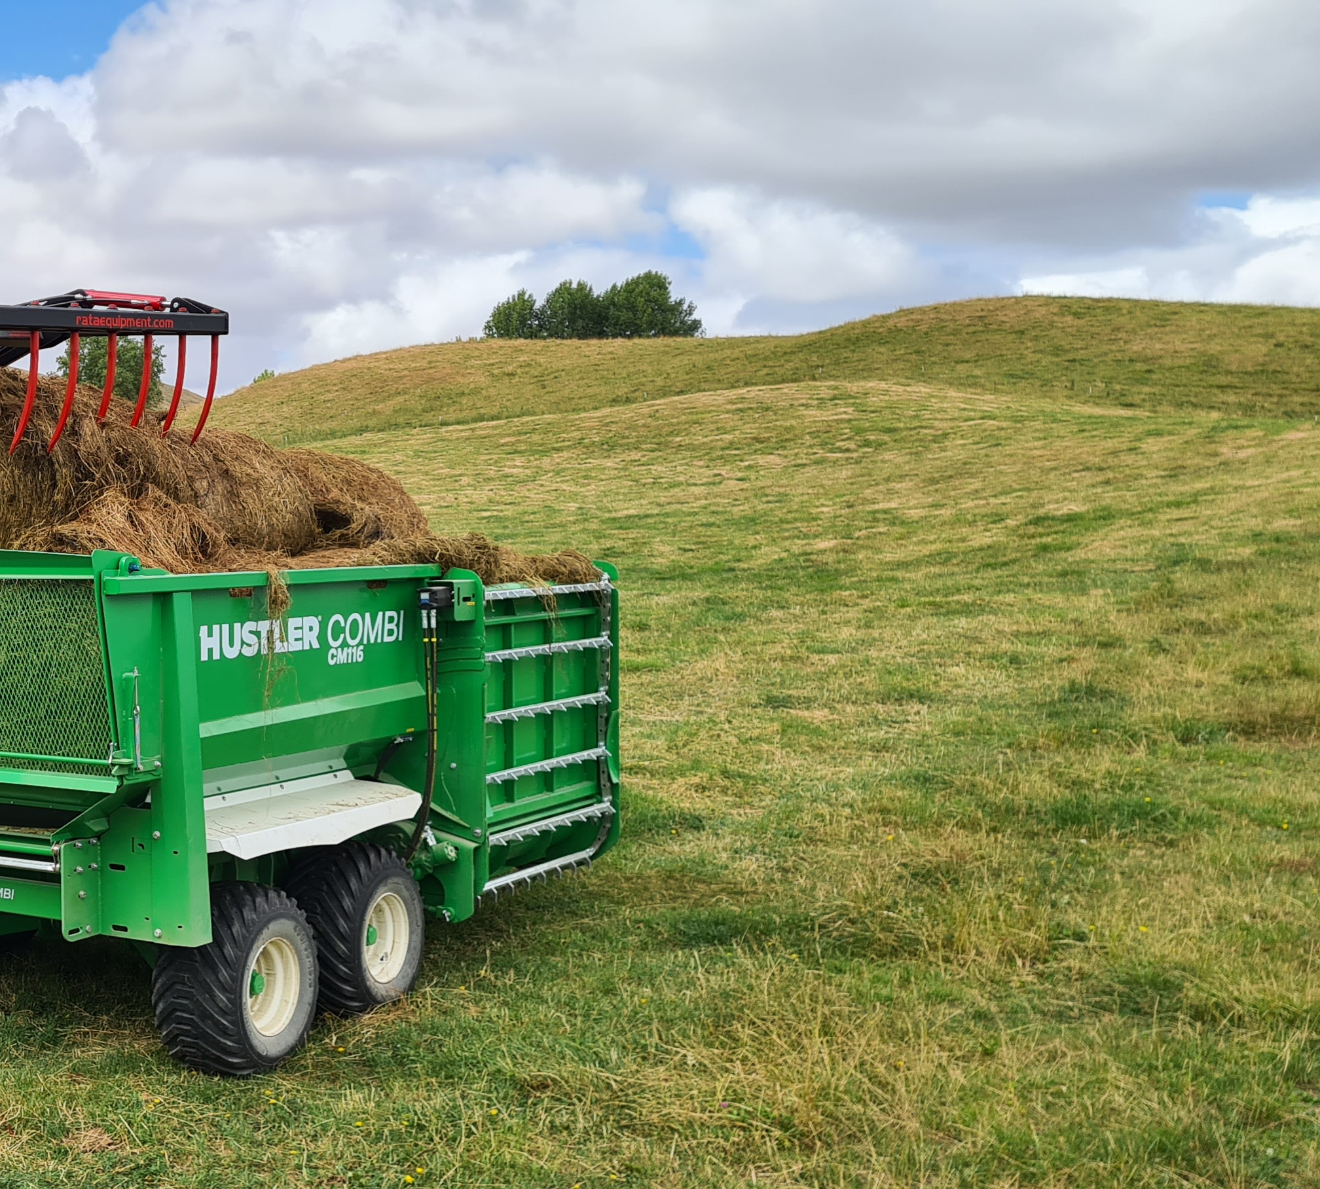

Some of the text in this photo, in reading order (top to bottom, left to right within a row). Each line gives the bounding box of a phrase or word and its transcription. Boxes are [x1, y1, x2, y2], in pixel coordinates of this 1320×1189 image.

[75, 314, 174, 329] rataequipment.com
[199, 610, 404, 661] HUSTLER COMBI
[328, 645, 364, 666] CM116
